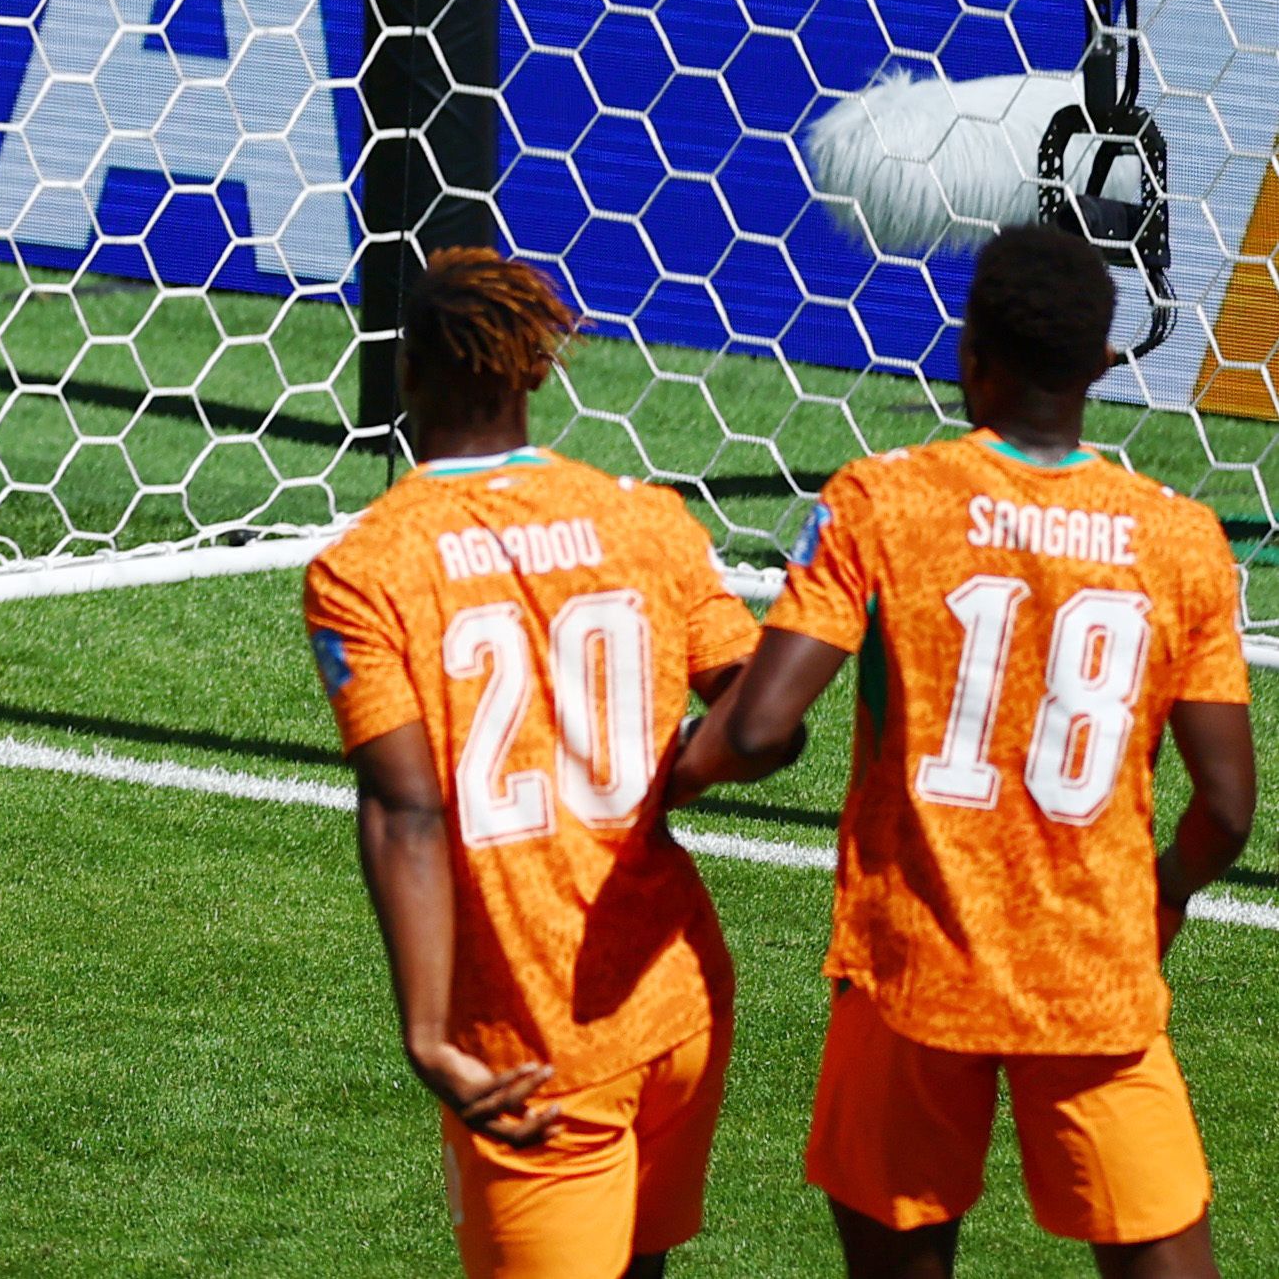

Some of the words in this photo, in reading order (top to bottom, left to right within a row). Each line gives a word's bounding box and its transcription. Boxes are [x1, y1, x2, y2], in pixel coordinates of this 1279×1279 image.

[966, 495, 1139, 566] SANGARE
[443, 587, 658, 850] 20
[914, 573, 1154, 827] 18
